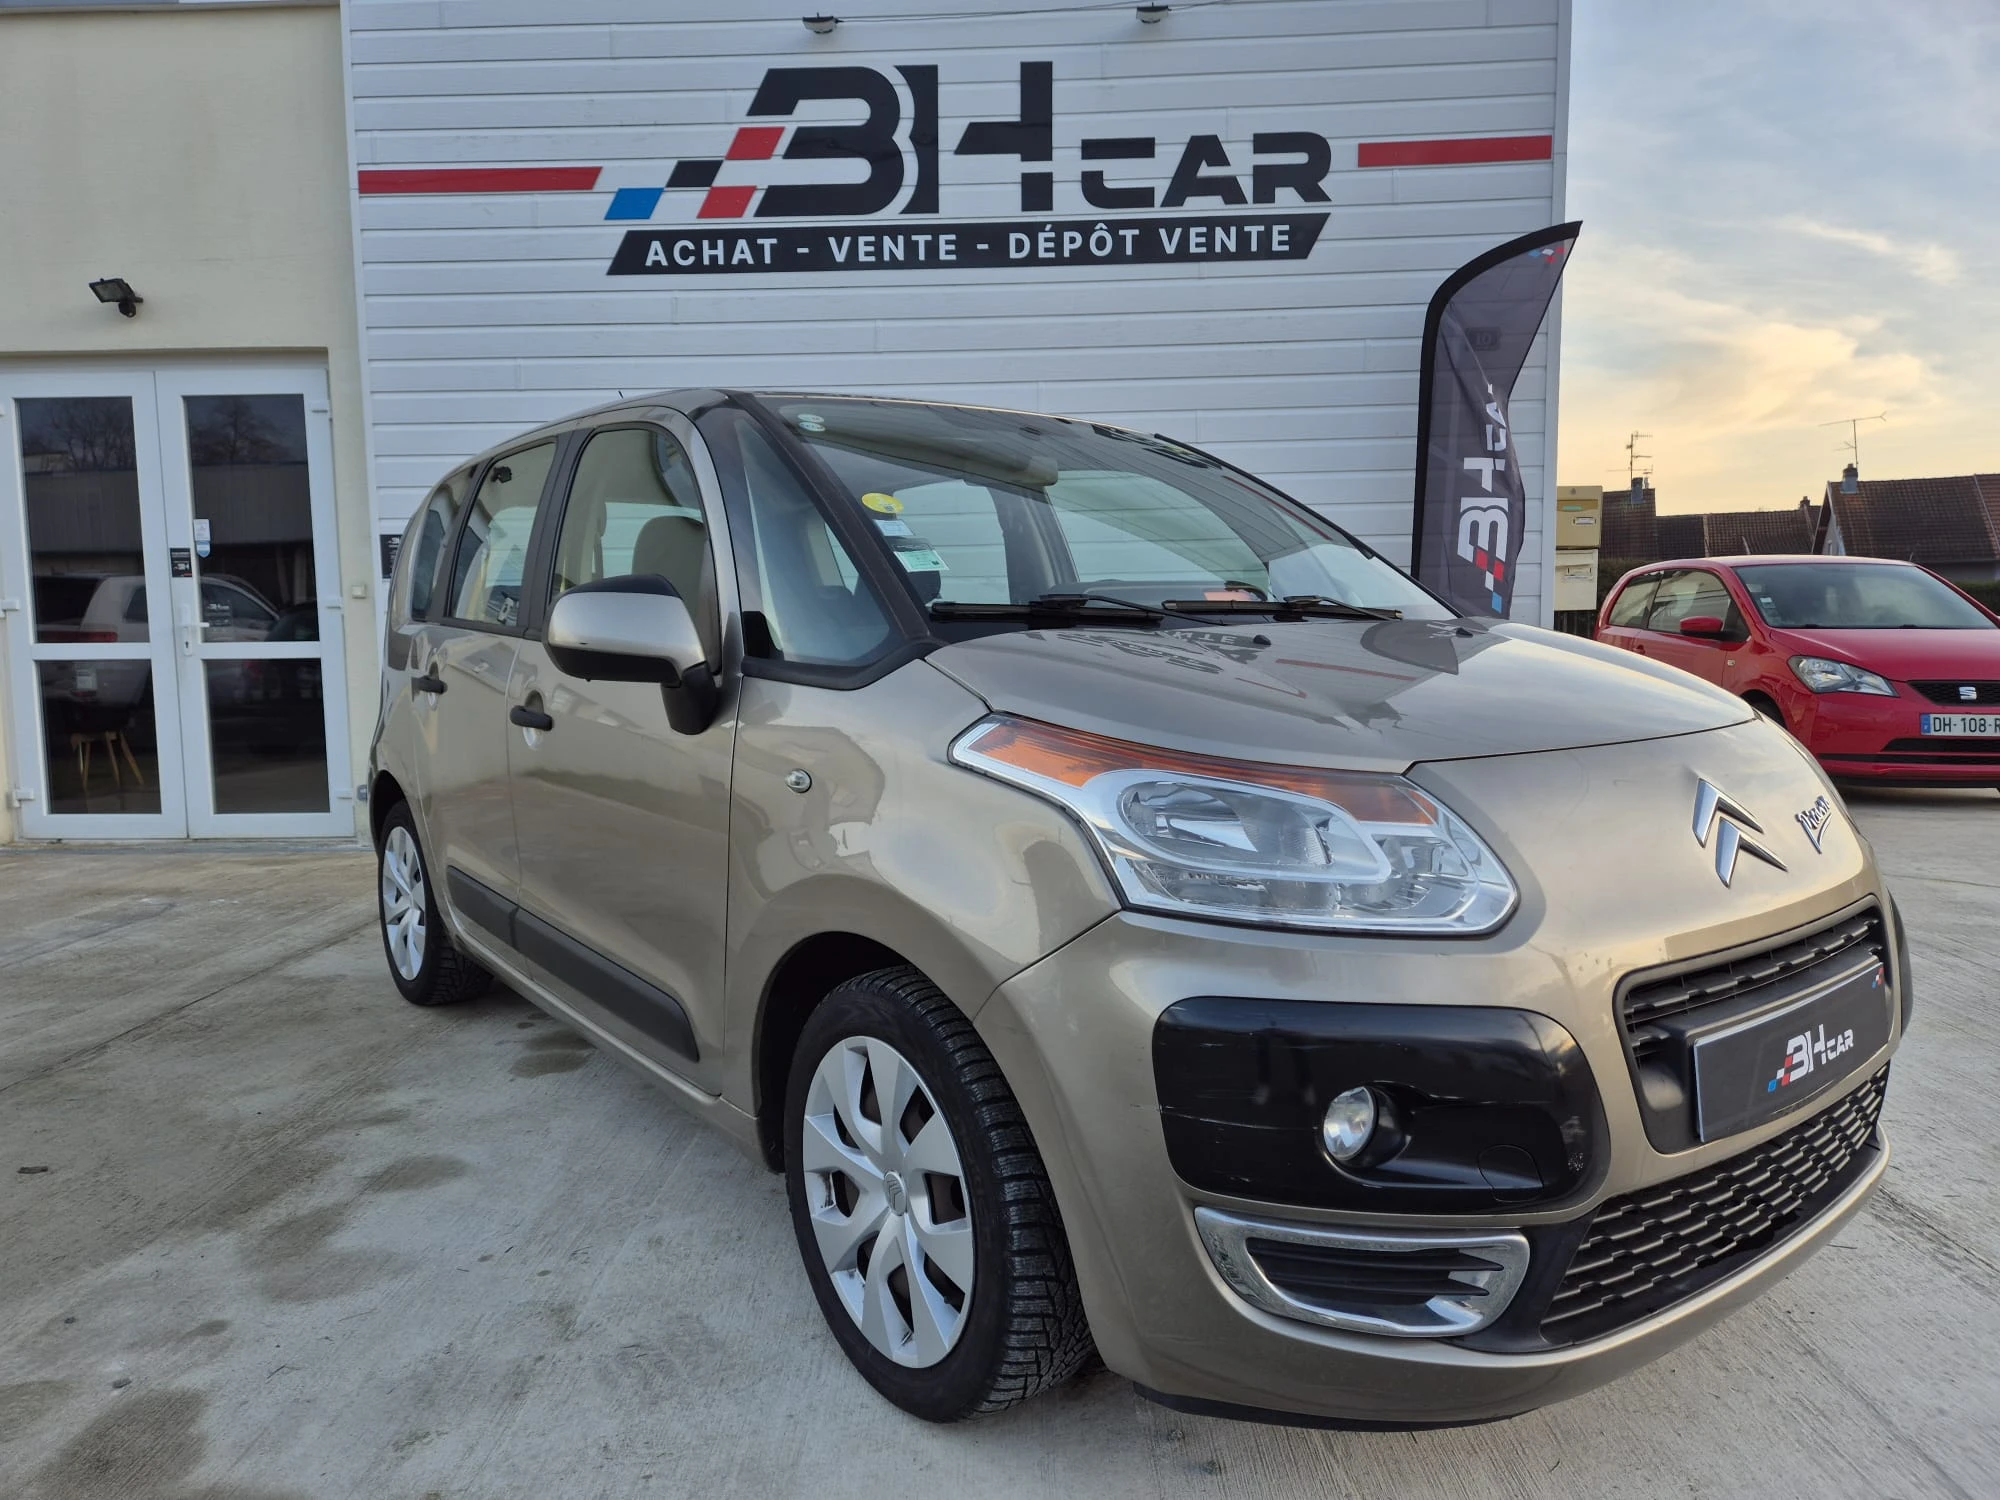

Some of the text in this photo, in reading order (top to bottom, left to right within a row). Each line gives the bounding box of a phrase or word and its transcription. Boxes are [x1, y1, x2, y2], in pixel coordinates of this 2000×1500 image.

[645, 238, 777, 266] ACHAT
[828, 234, 957, 262] VENTE
[1009, 222, 1140, 259] DÉPÔT
[1159, 224, 1290, 254] VENTE
